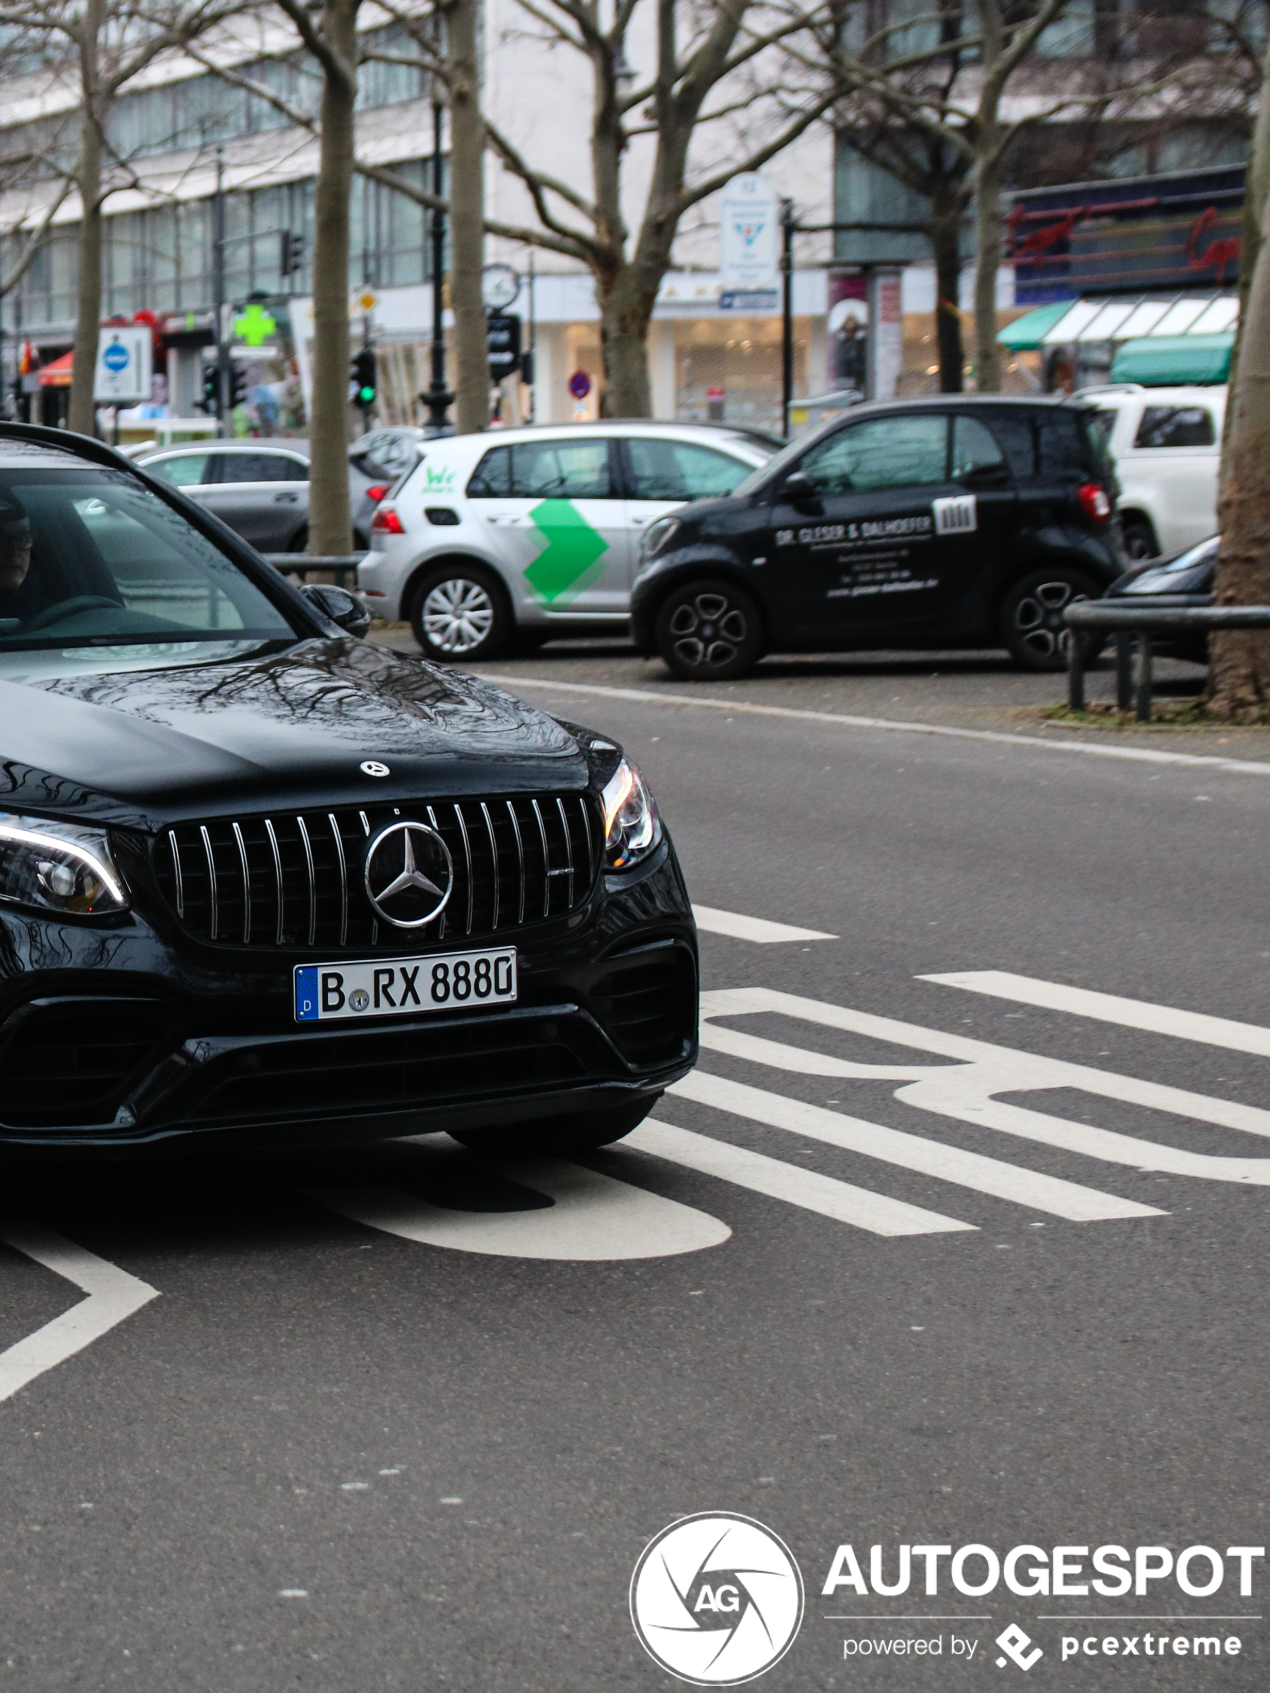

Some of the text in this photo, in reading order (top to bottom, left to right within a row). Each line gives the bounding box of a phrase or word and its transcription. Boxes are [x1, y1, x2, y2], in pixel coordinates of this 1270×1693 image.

[321, 955, 513, 1012] B RX 8880
[303, 1000, 312, 1012] D
